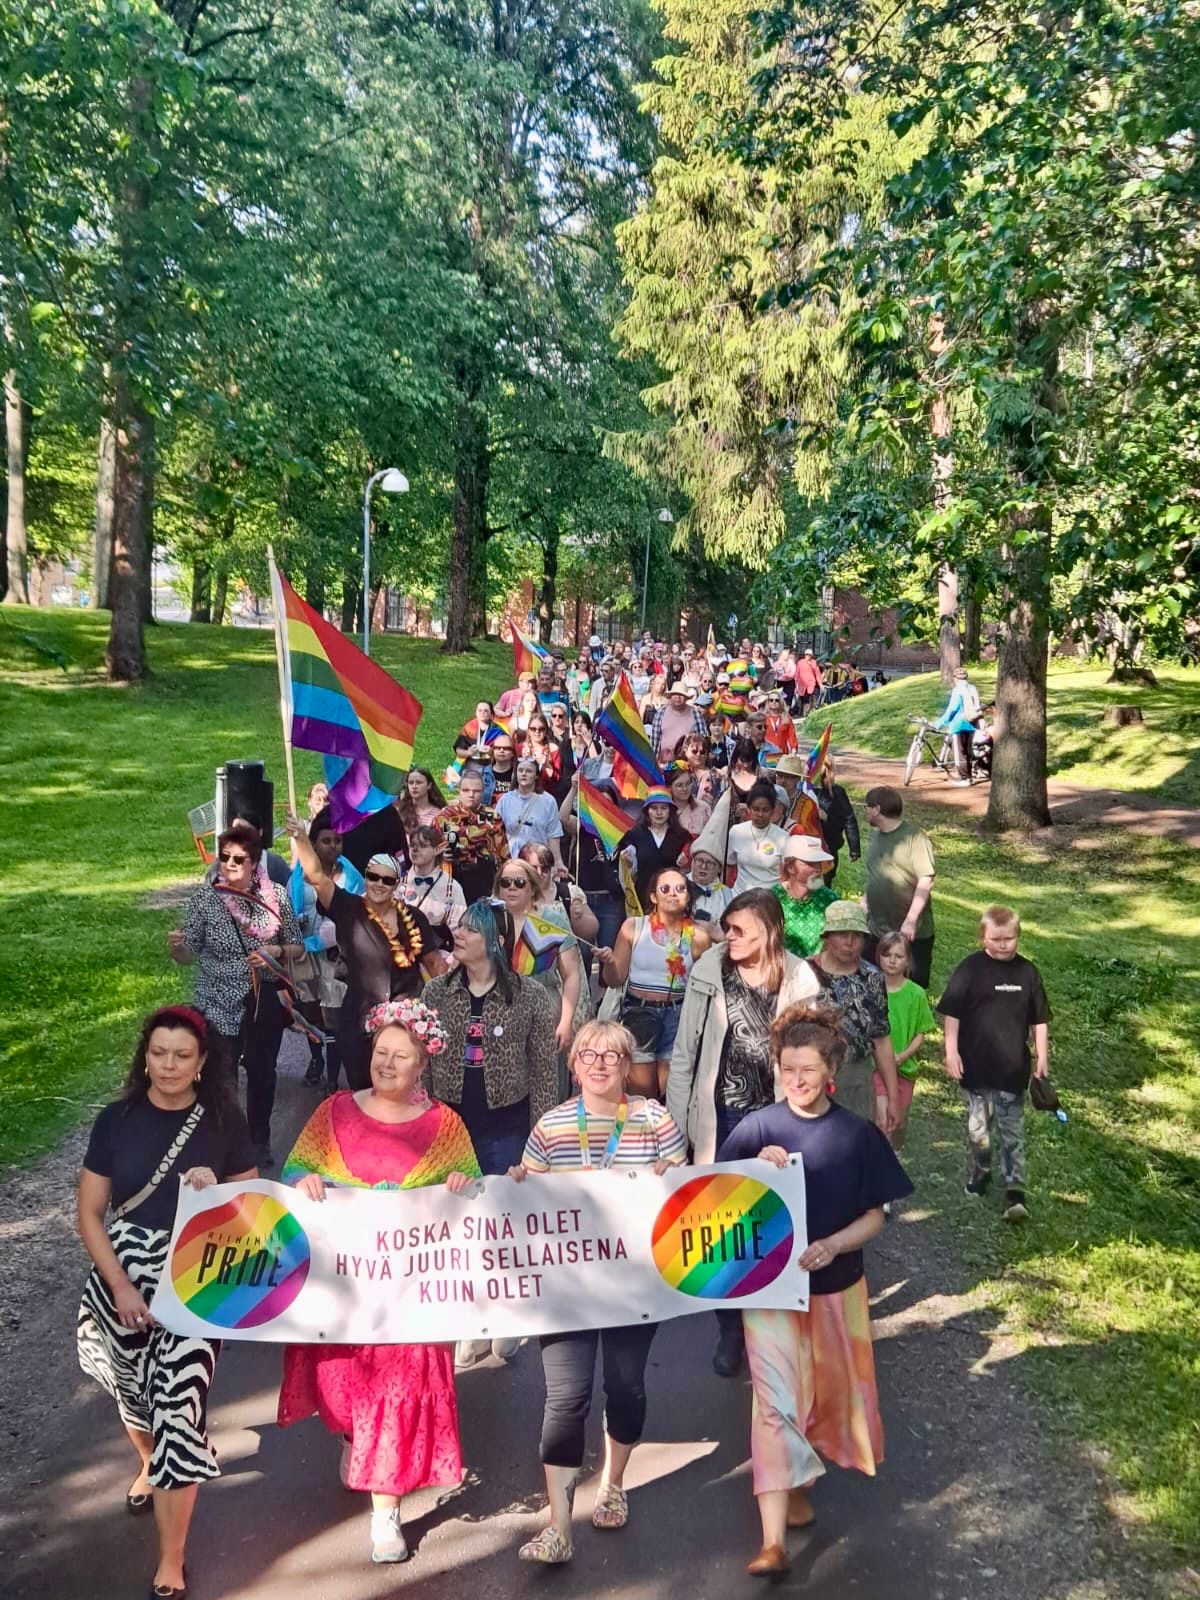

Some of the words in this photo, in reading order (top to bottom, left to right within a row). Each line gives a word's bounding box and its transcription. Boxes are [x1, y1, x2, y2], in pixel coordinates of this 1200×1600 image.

[376, 1220, 452, 1252] KOSKA
[463, 1213, 515, 1241] SINÄ
[526, 1209, 582, 1236] OLET
[680, 1208, 763, 1224] RIIHIMÄKI
[197, 1241, 283, 1288] PRIDE
[336, 1253, 392, 1281] HYVÄ
[404, 1247, 471, 1277] JUURI
[481, 1237, 628, 1271] SELLAISENA
[681, 1221, 765, 1267] PRIDE
[420, 1279, 475, 1304] KUIN
[486, 1274, 543, 1300] OLET
